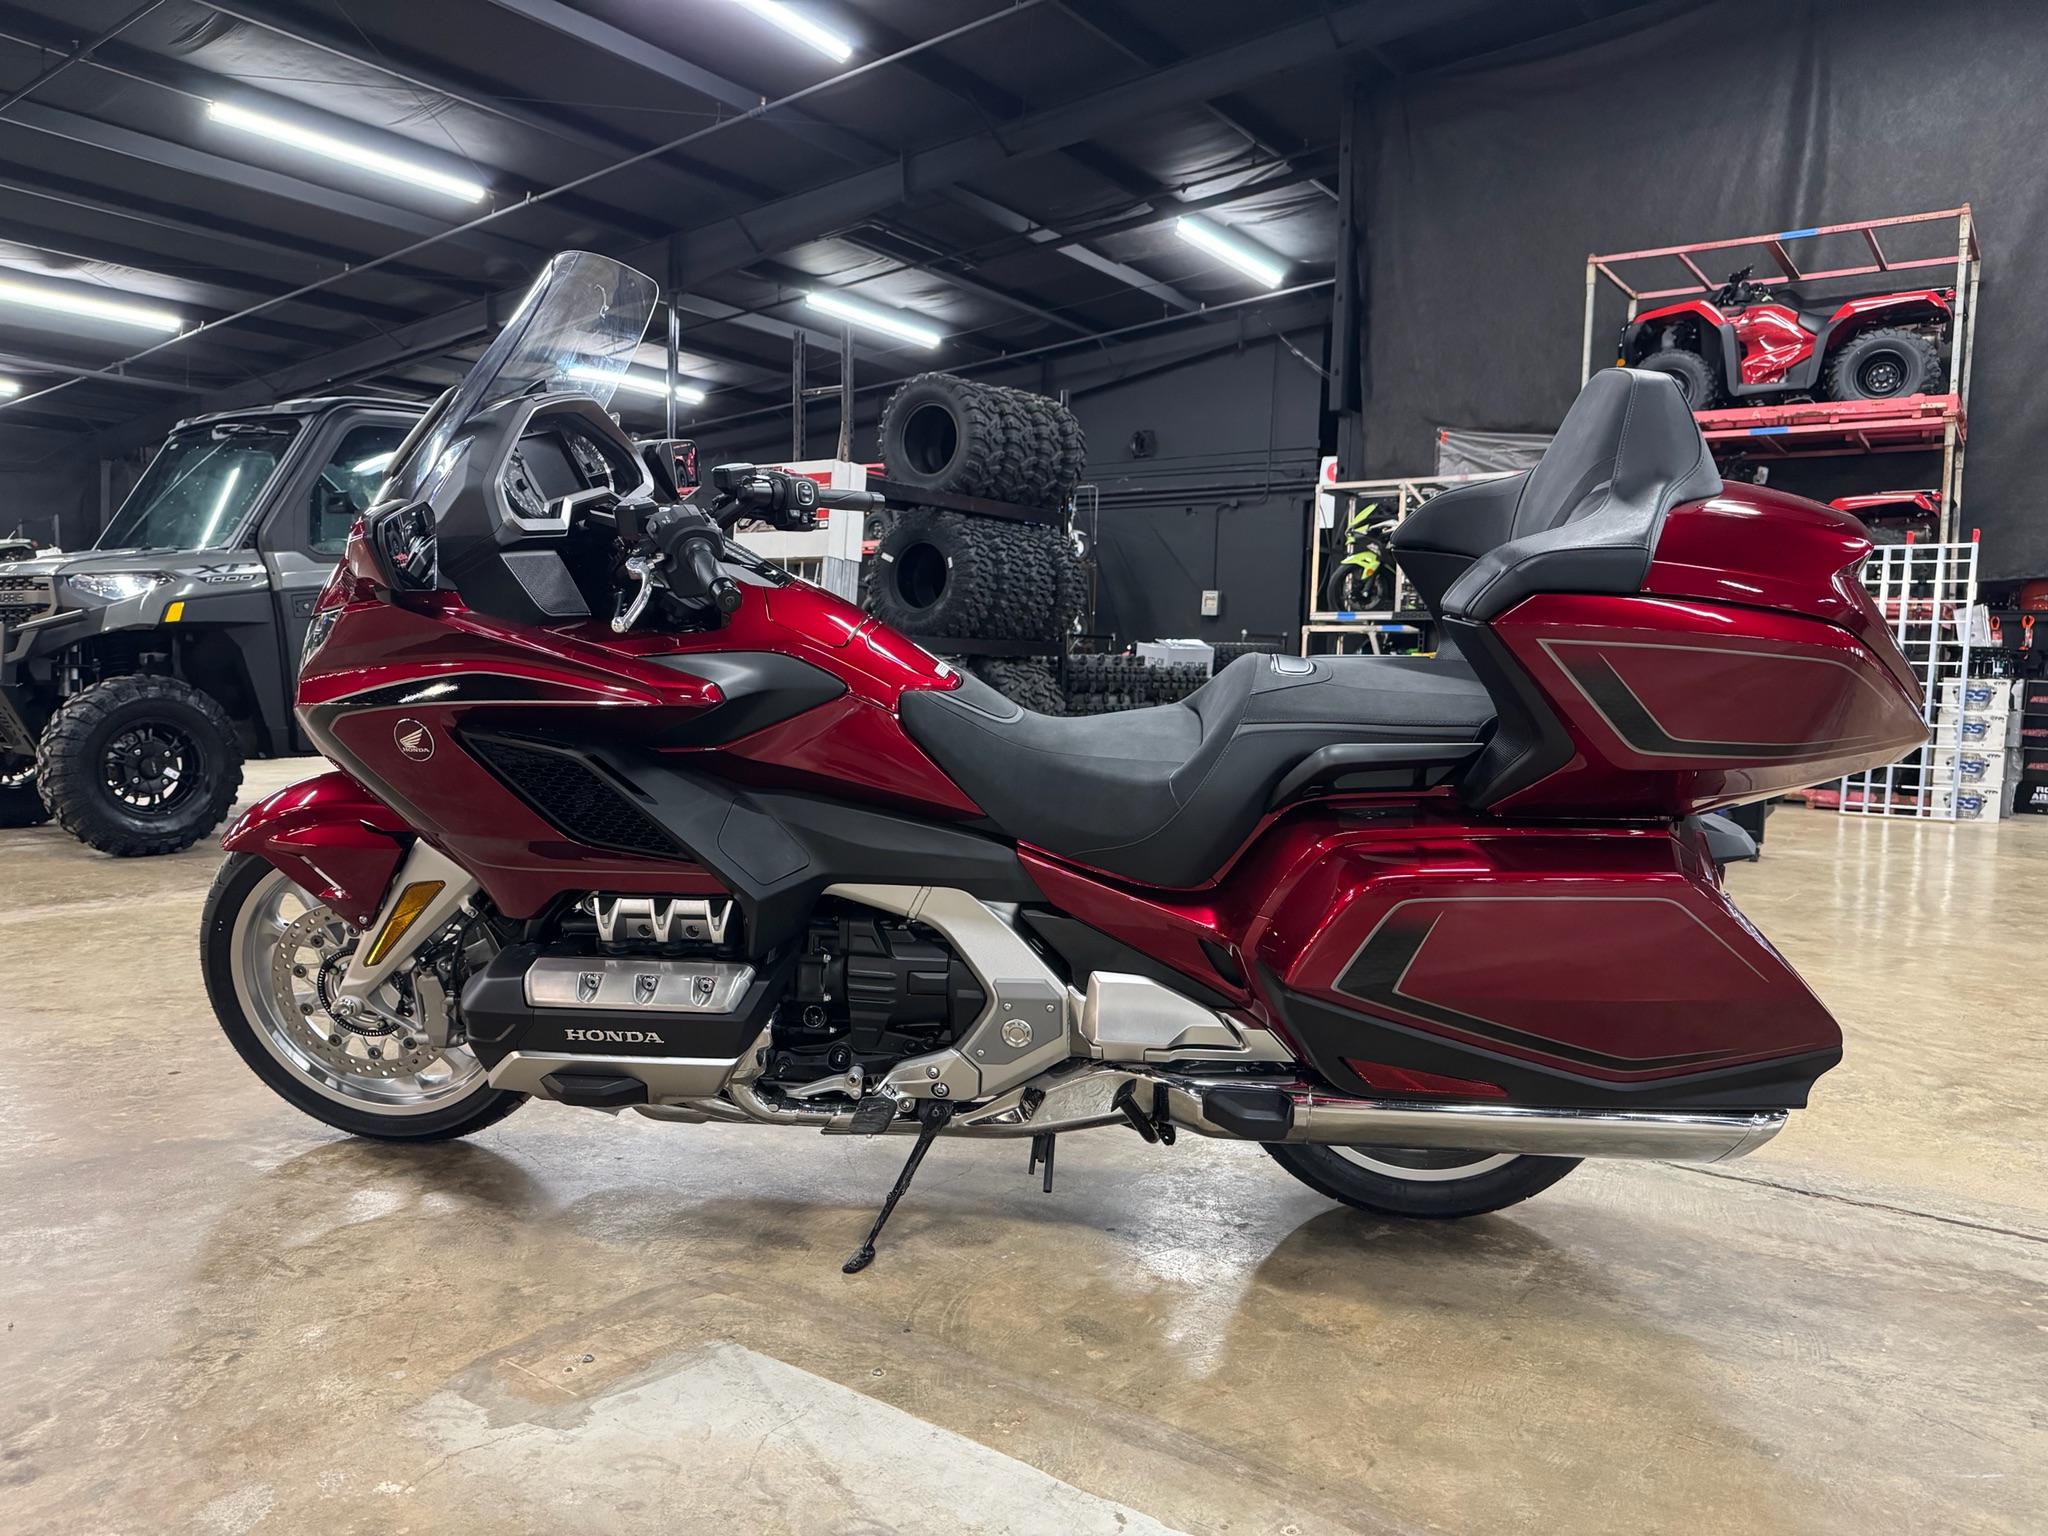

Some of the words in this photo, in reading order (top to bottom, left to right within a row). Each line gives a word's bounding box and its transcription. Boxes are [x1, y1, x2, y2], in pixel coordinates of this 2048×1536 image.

[193, 563, 257, 575] XP
[206, 574, 255, 583] 1000
[564, 1029, 665, 1044] HONDA
